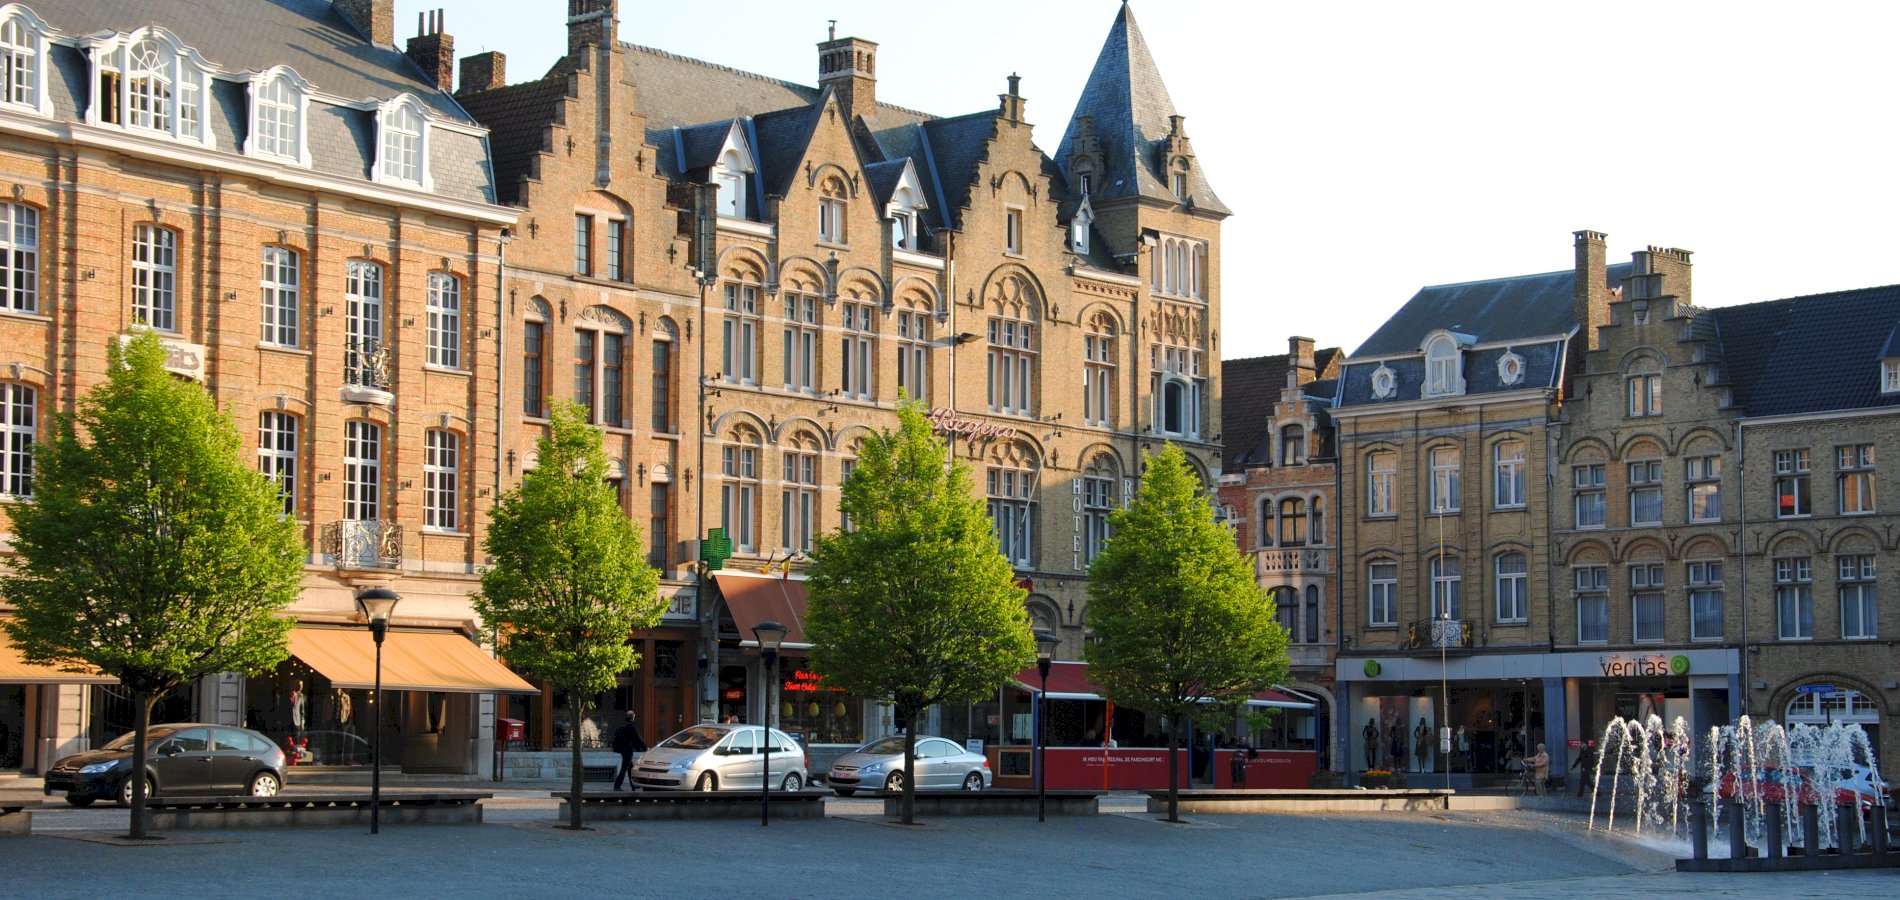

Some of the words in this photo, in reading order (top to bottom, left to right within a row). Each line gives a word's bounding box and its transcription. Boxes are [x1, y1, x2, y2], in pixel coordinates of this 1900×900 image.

[927, 407, 1017, 442] Regina
[1123, 479, 1133, 512] RE
[1072, 478, 1081, 571] HOTEL
[1600, 657, 1668, 677] veritas
